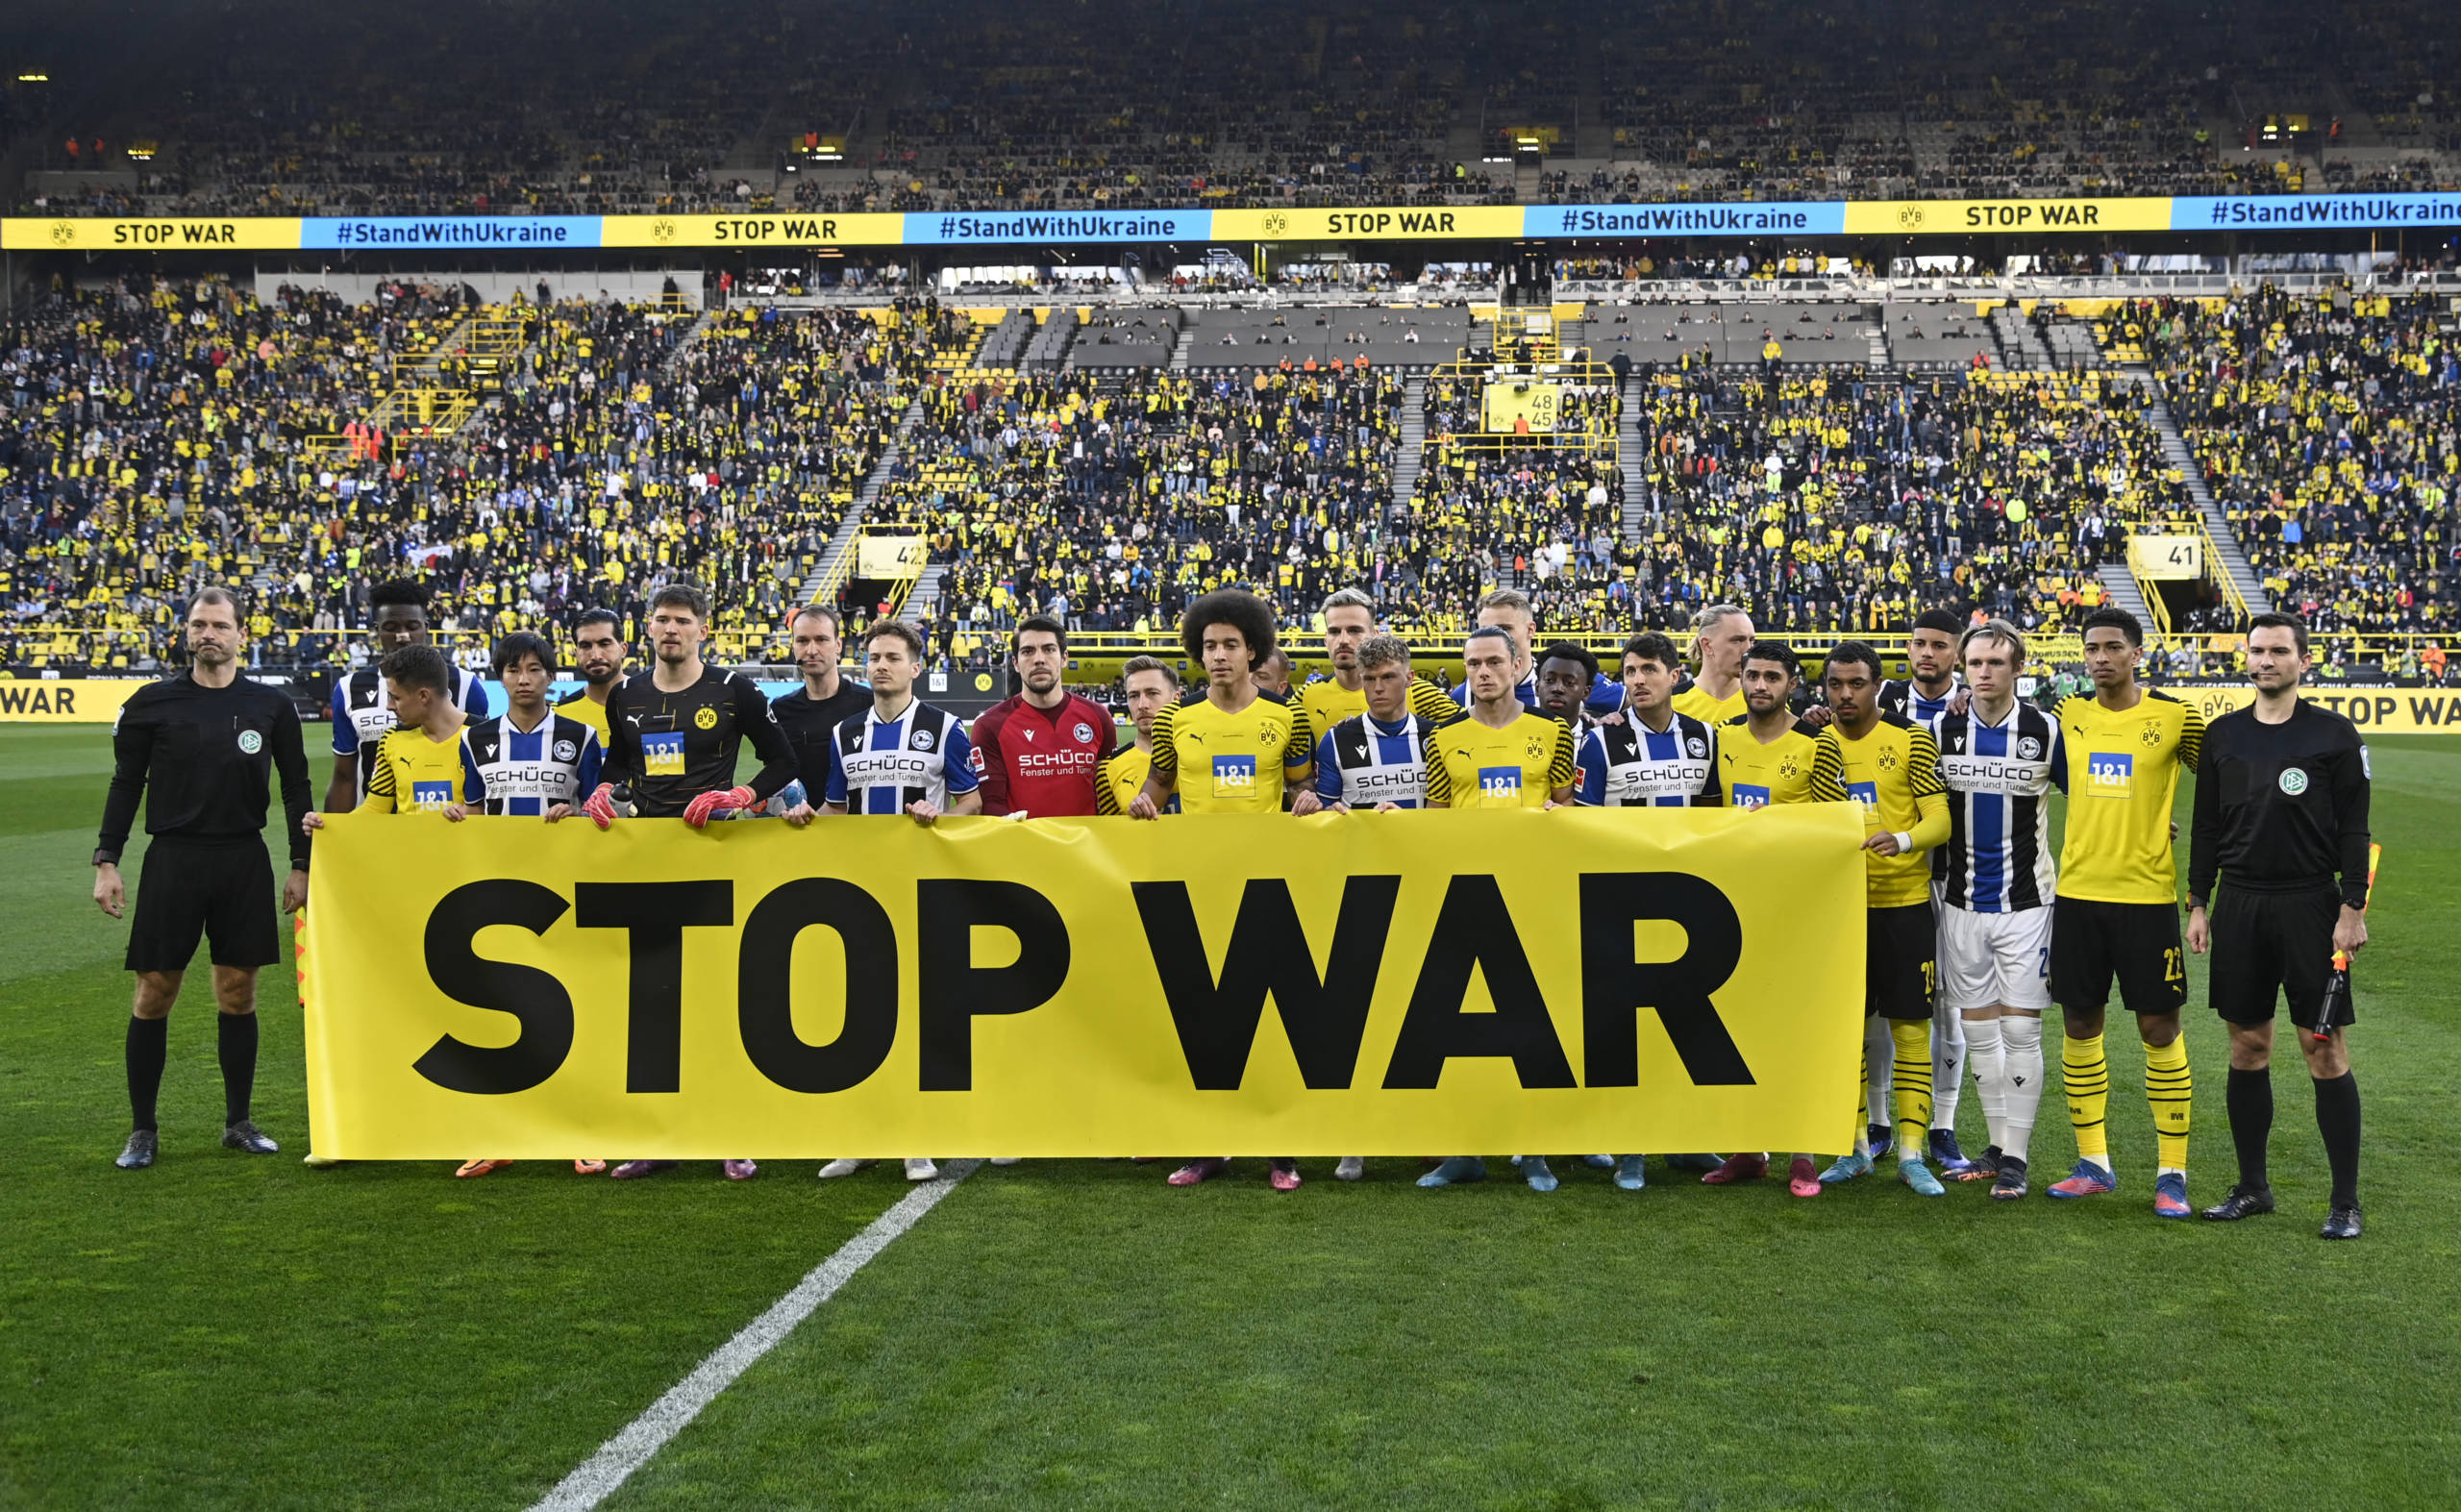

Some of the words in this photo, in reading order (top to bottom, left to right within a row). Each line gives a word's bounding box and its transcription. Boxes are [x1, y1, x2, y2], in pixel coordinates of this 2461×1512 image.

[1265, 213, 1285, 230] BVB
[1328, 213, 1390, 234] STOP
[1398, 212, 1454, 233] WAR
[1562, 209, 1806, 232] #StandWithUkraine
[1901, 207, 1922, 223] BVB
[1966, 206, 2031, 226] STOP
[2040, 205, 2099, 226] WAR
[113, 224, 174, 243] STOP
[182, 223, 236, 243] WAR
[337, 222, 567, 243] #StandWithUkraine
[654, 221, 674, 236] BVB
[714, 220, 775, 239] STOP
[783, 219, 836, 239] WAR
[940, 217, 1176, 238] #StandWithUkraine
[1531, 394, 1552, 409] 48
[1531, 411, 1552, 426] 45
[897, 546, 922, 565] 42
[2169, 546, 2192, 565] 41
[931, 677, 946, 687] 1&1
[0, 687, 75, 714] WAR
[698, 709, 714, 723] BVB
[2409, 697, 2461, 725] WA
[1261, 729, 1277, 742] BVB
[2143, 729, 2160, 744] BVB
[646, 742, 680, 765] 1&1
[1018, 749, 1095, 766] SCHÜCO
[1528, 743, 1543, 756] BVB
[846, 755, 925, 775] SCHÜCO
[1780, 762, 1797, 775] BVB
[1878, 754, 1896, 767] BVB
[485, 766, 567, 784] SCHÜCO
[849, 775, 876, 784] Fenster
[879, 773, 895, 781] und
[897, 772, 921, 782] Türen
[1020, 768, 1055, 777] Fenster
[1056, 766, 1074, 775] und
[1216, 765, 1251, 786] 1&1
[1356, 769, 1428, 788] SCHÜC
[1626, 764, 1704, 783] SCHÜCO
[1948, 762, 2032, 781] SCHÜCO
[2093, 762, 2126, 786] 1&1
[520, 783, 538, 793] und
[1358, 789, 1394, 799] Fenster
[1397, 785, 1414, 795] und
[1483, 776, 1517, 798] 1&1
[1628, 784, 1661, 793] Fenster
[1664, 782, 1681, 791] und
[1982, 781, 2001, 789] und
[2005, 781, 2029, 792] Türen
[416, 791, 448, 810] 1&1
[2164, 946, 2183, 981] 22
[412, 877, 1070, 1095] STOP
[1129, 871, 1756, 1091] WAR
